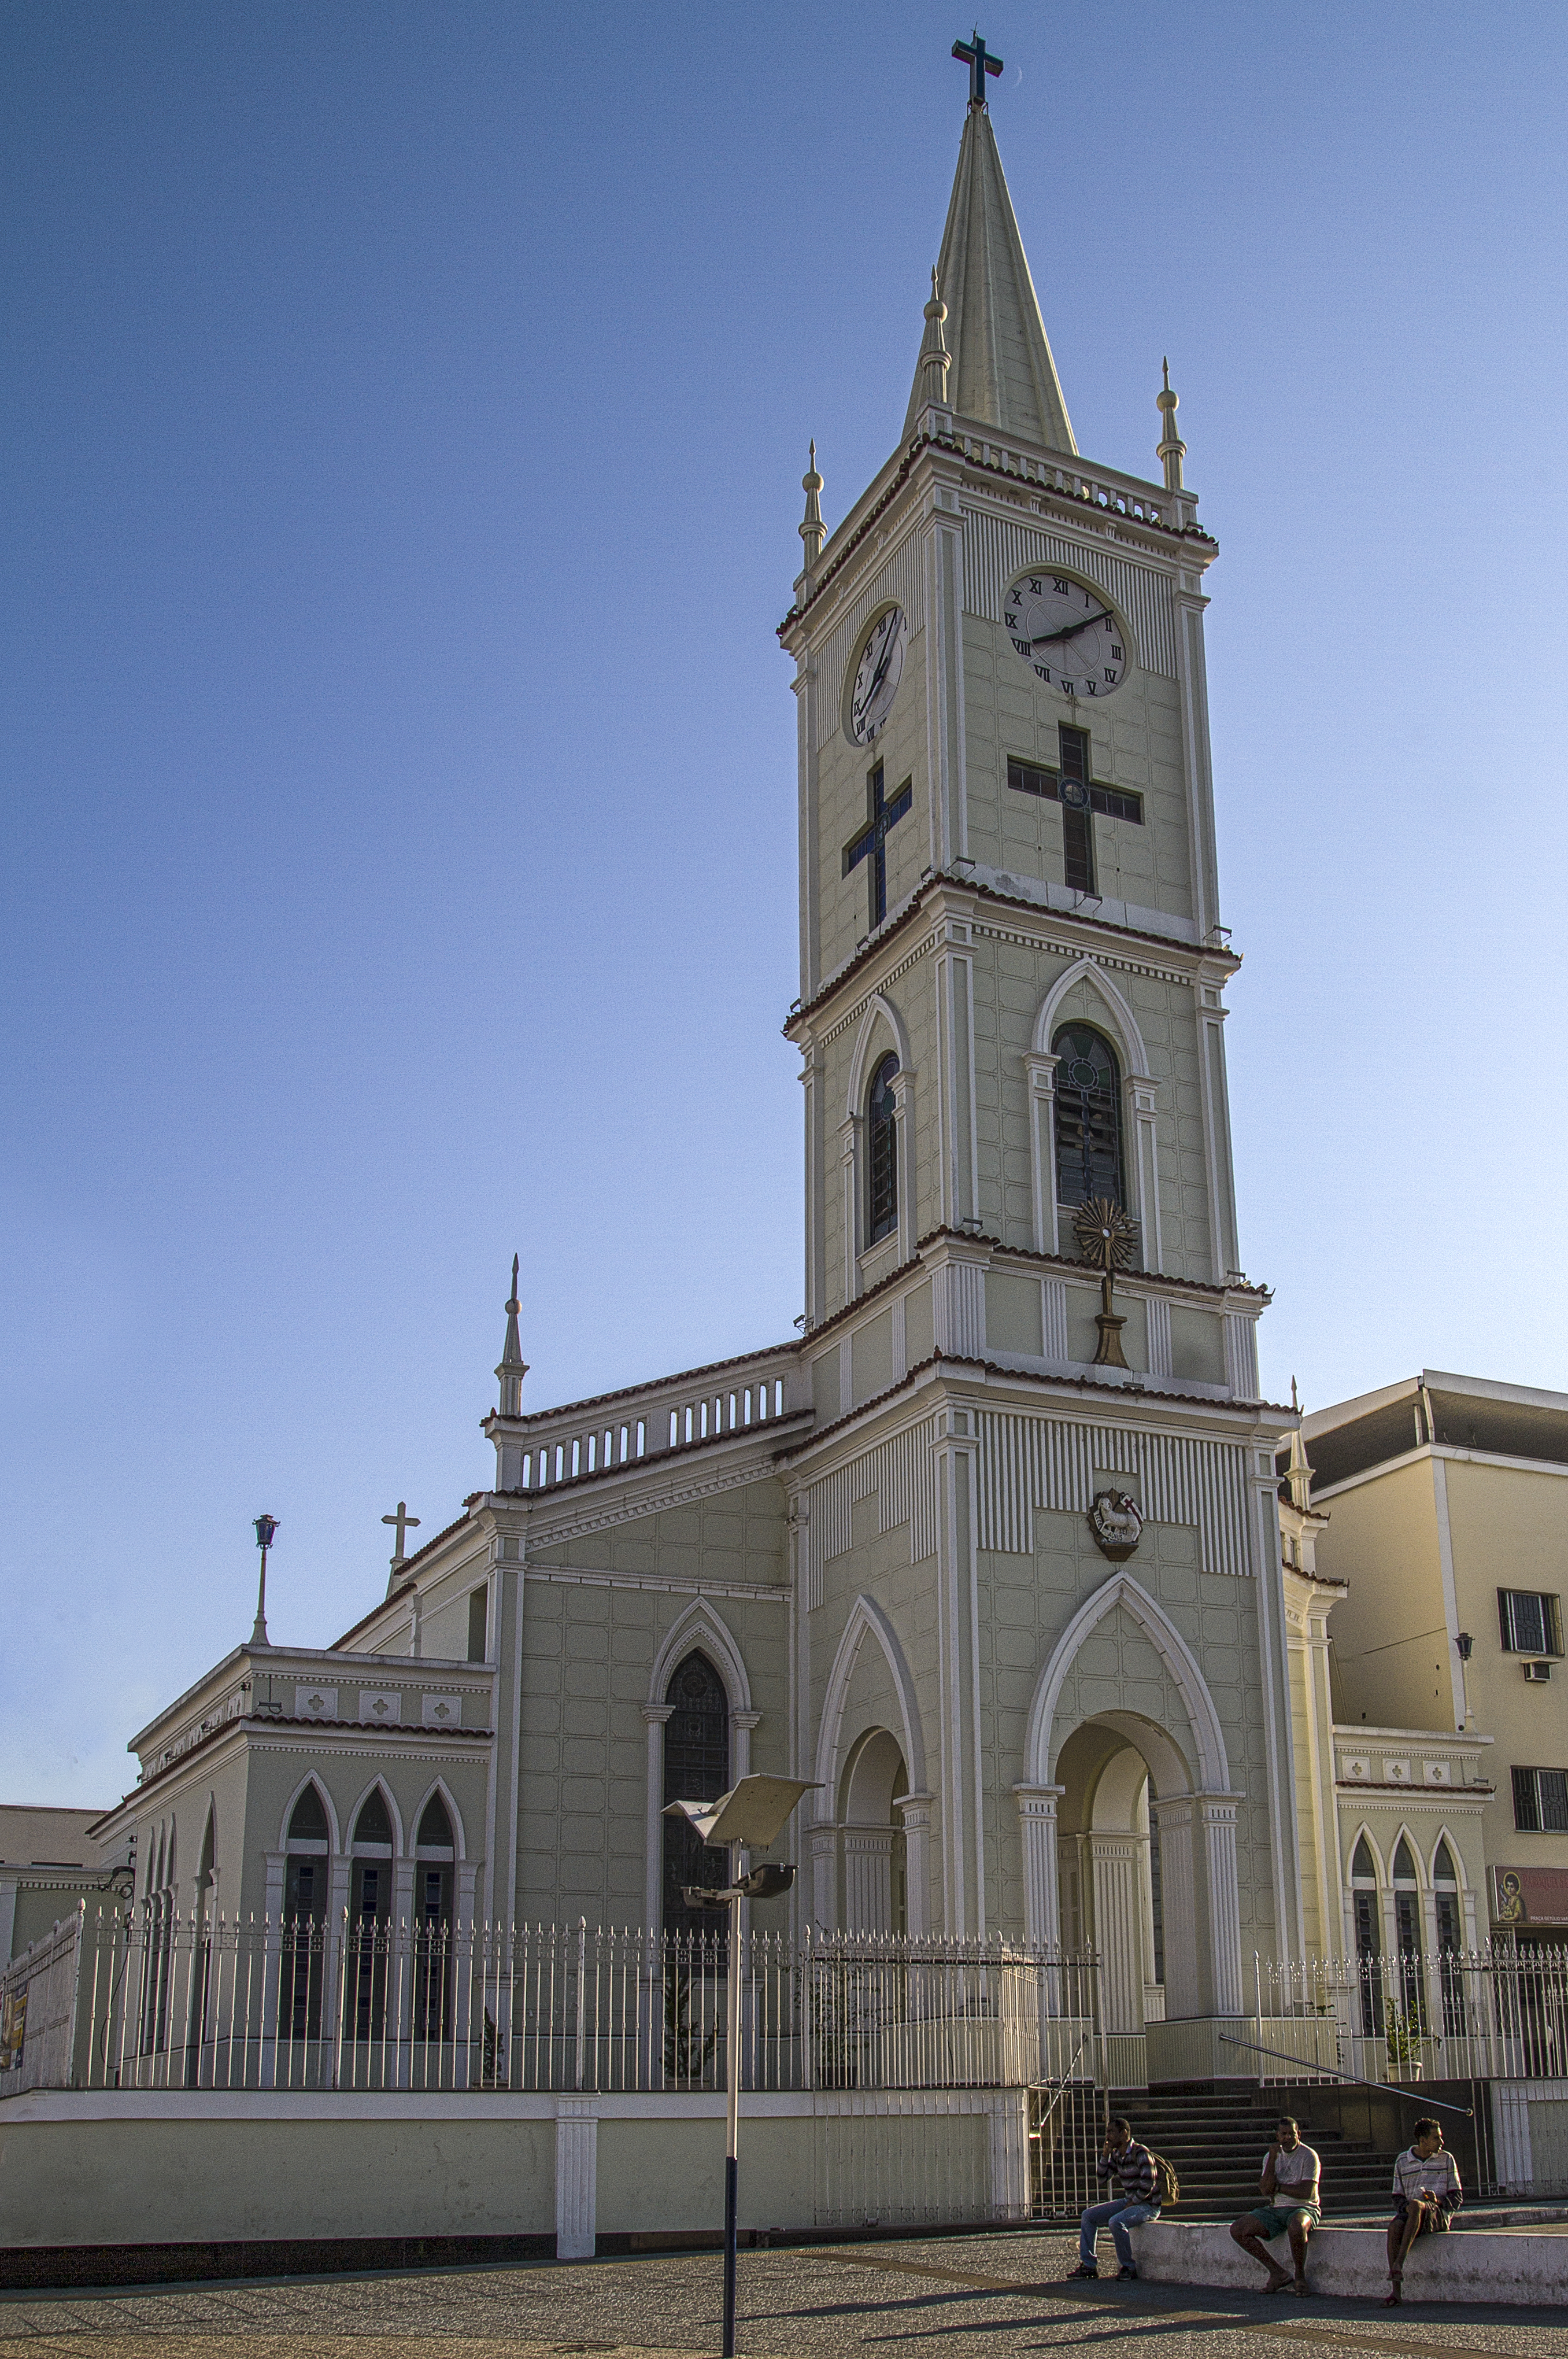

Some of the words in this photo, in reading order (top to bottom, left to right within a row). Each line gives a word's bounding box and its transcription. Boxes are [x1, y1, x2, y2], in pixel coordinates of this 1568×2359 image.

[1029, 578, 1042, 595] XI
[1052, 578, 1068, 596] XII
[1011, 589, 1022, 606] X
[1085, 594, 1089, 608] I
[878, 616, 886, 638] XII
[1004, 612, 1018, 629] IX
[1105, 618, 1112, 632] II
[866, 641, 873, 660] XI
[1011, 637, 1031, 657] VIII
[1111, 645, 1122, 660] III
[857, 671, 863, 690] X
[1033, 664, 1051, 683] VII
[1104, 667, 1118, 685] IV
[1060, 680, 1074, 695] VI
[1086, 680, 1098, 696] V
[854, 697, 861, 717] IX
[856, 715, 866, 738] VIII
[867, 723, 875, 743] VII
